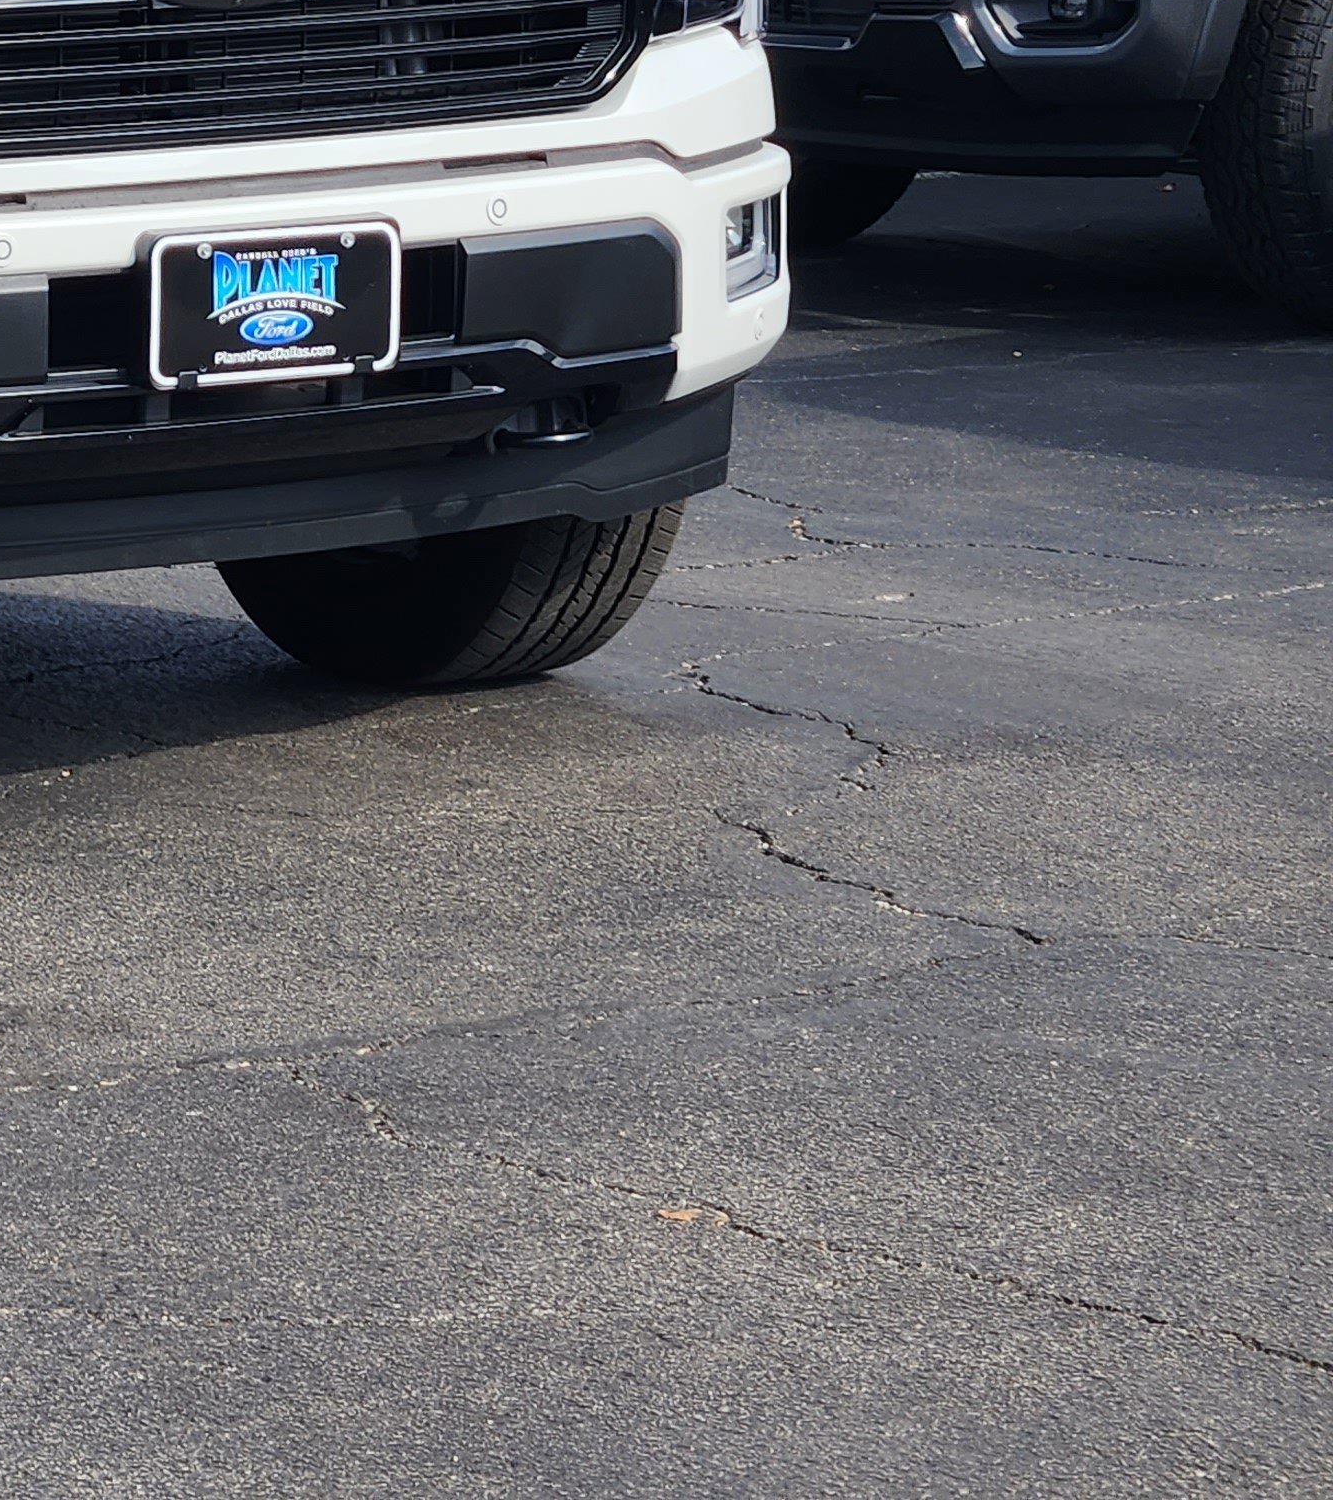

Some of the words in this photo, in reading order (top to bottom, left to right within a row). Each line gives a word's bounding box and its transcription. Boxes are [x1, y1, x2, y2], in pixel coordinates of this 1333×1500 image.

[213, 250, 339, 312] PLANET
[218, 301, 265, 325] DALLAS
[267, 299, 297, 309] LOVE
[300, 300, 335, 318] FIELD
[253, 316, 299, 339] Ford
